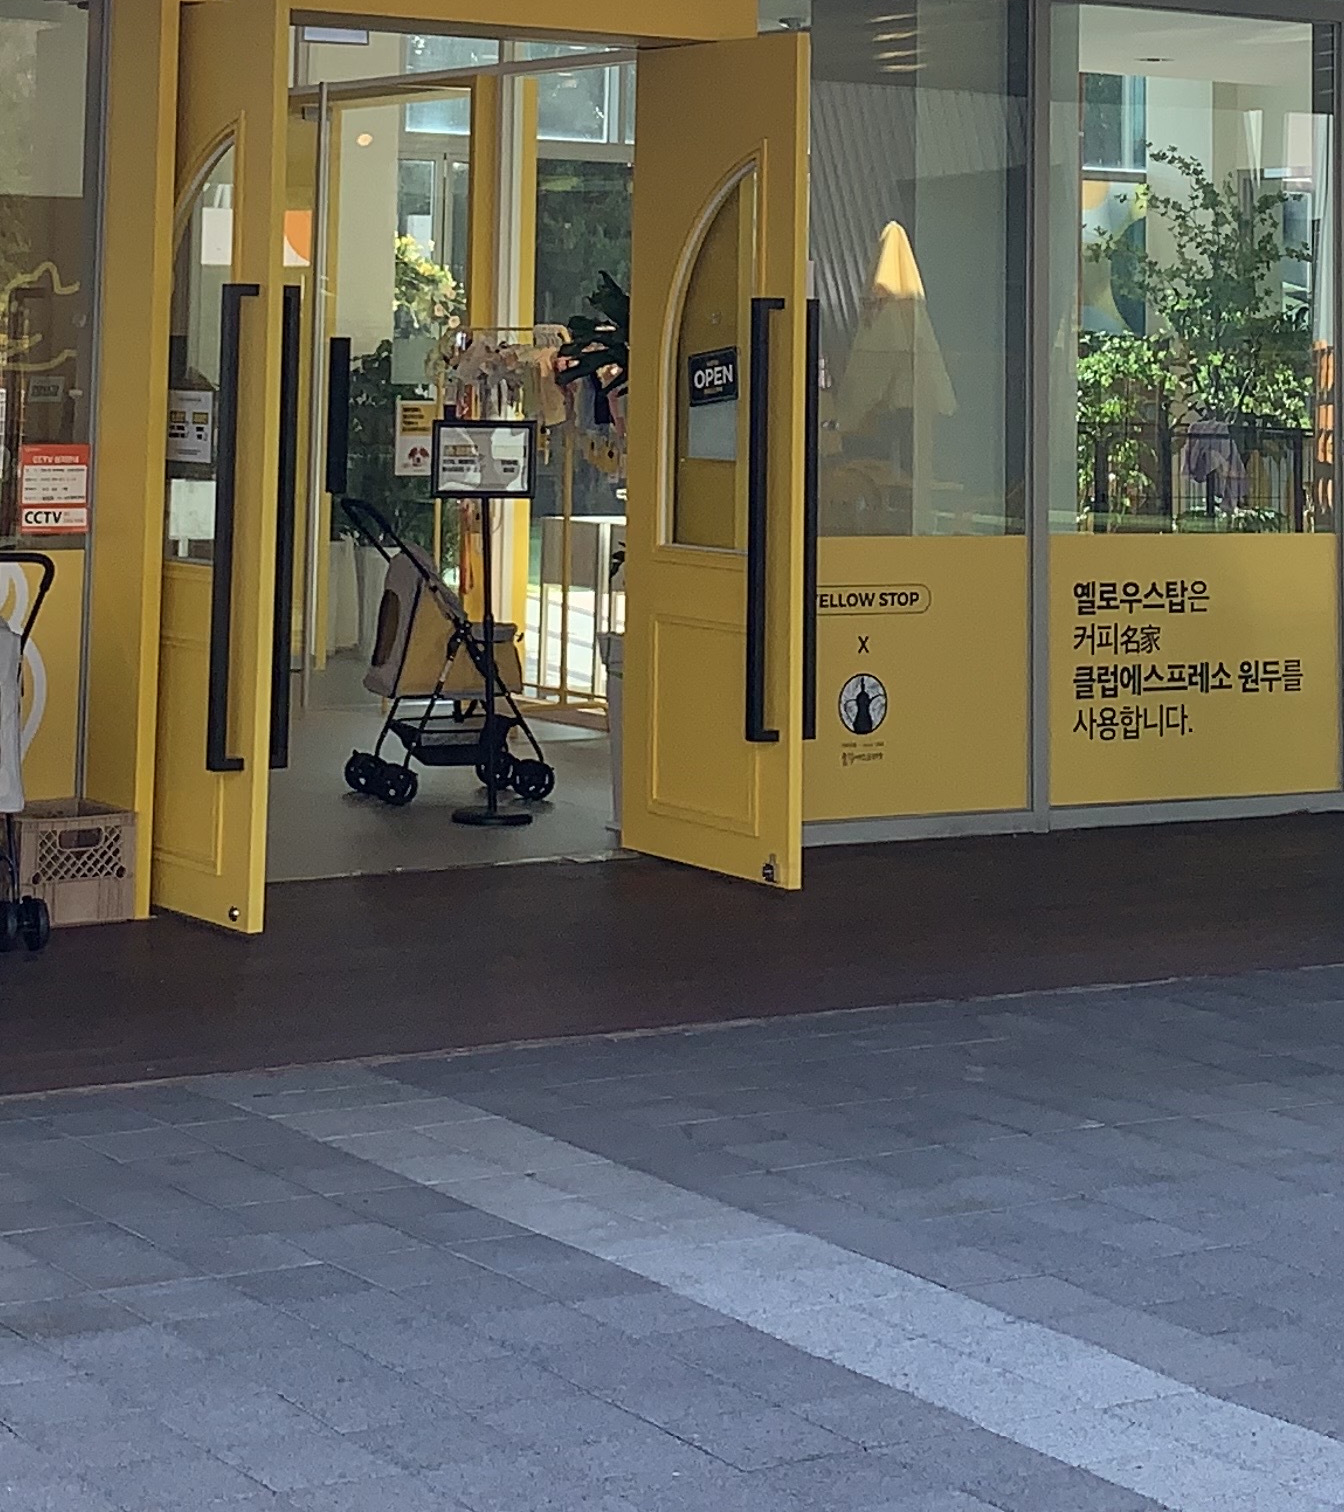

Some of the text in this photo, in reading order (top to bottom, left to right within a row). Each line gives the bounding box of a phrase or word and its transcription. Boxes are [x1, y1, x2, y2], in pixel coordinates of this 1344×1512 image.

[693, 364, 734, 389] OPEN
[24, 510, 63, 525] CCTV
[816, 591, 920, 609] ELLOW STOP
[1072, 579, 1211, 616] 옐로우스탑은
[1072, 622, 1162, 656] 커피名家
[1072, 658, 1304, 700] 클럽에스프레소 원두를
[1072, 703, 1194, 741] 사용합니다.
